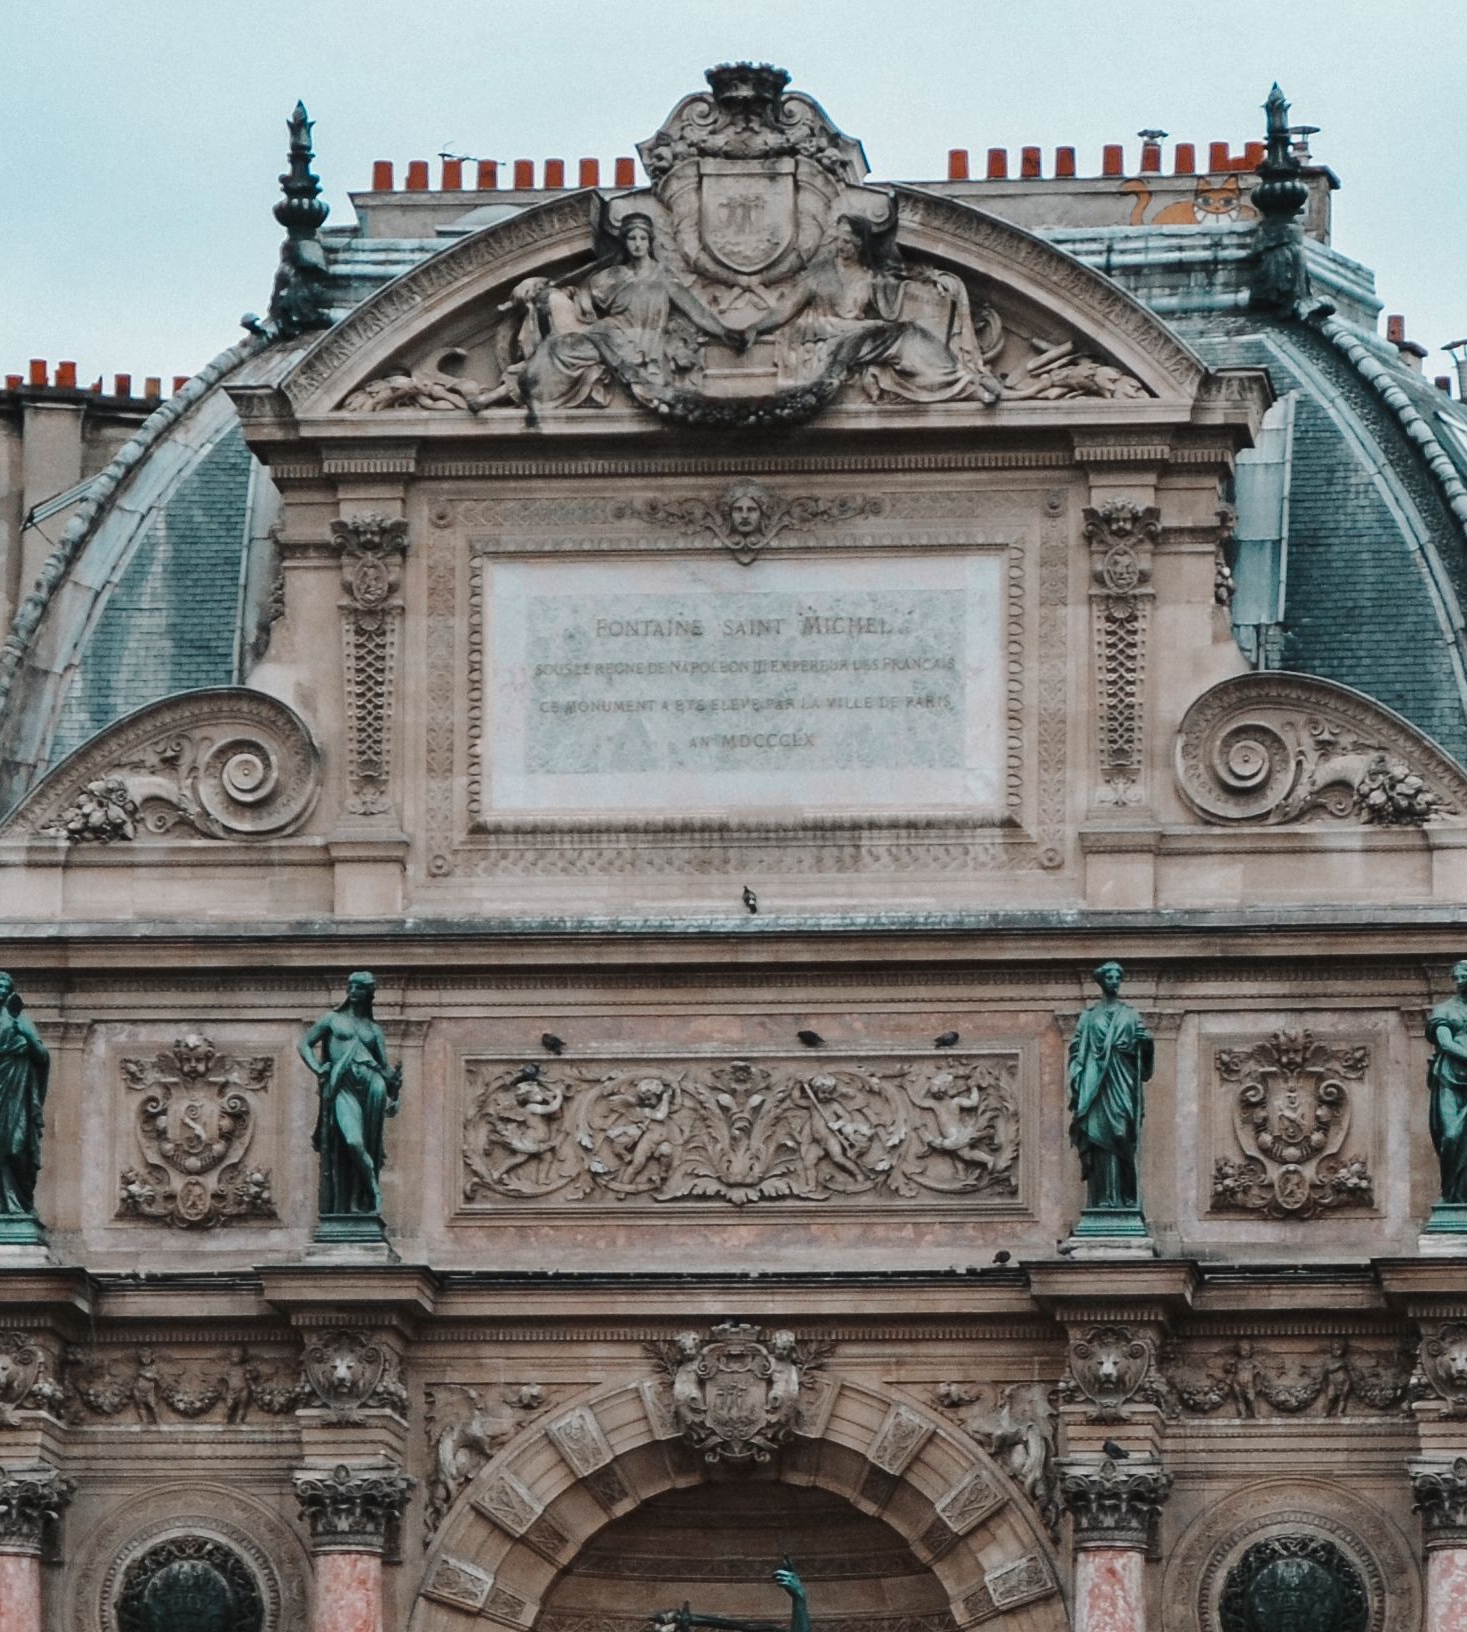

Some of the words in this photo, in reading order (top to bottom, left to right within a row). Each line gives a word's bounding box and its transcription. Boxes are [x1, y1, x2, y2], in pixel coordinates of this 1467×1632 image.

[595, 617, 704, 638] FONTAINE
[722, 618, 785, 637] SAINT
[800, 616, 893, 637] MICHEL
[647, 662, 666, 675] DE
[563, 700, 656, 714] MONUMENT
[801, 698, 821, 710] LA
[827, 697, 872, 710] VILLE
[879, 697, 898, 709] DE
